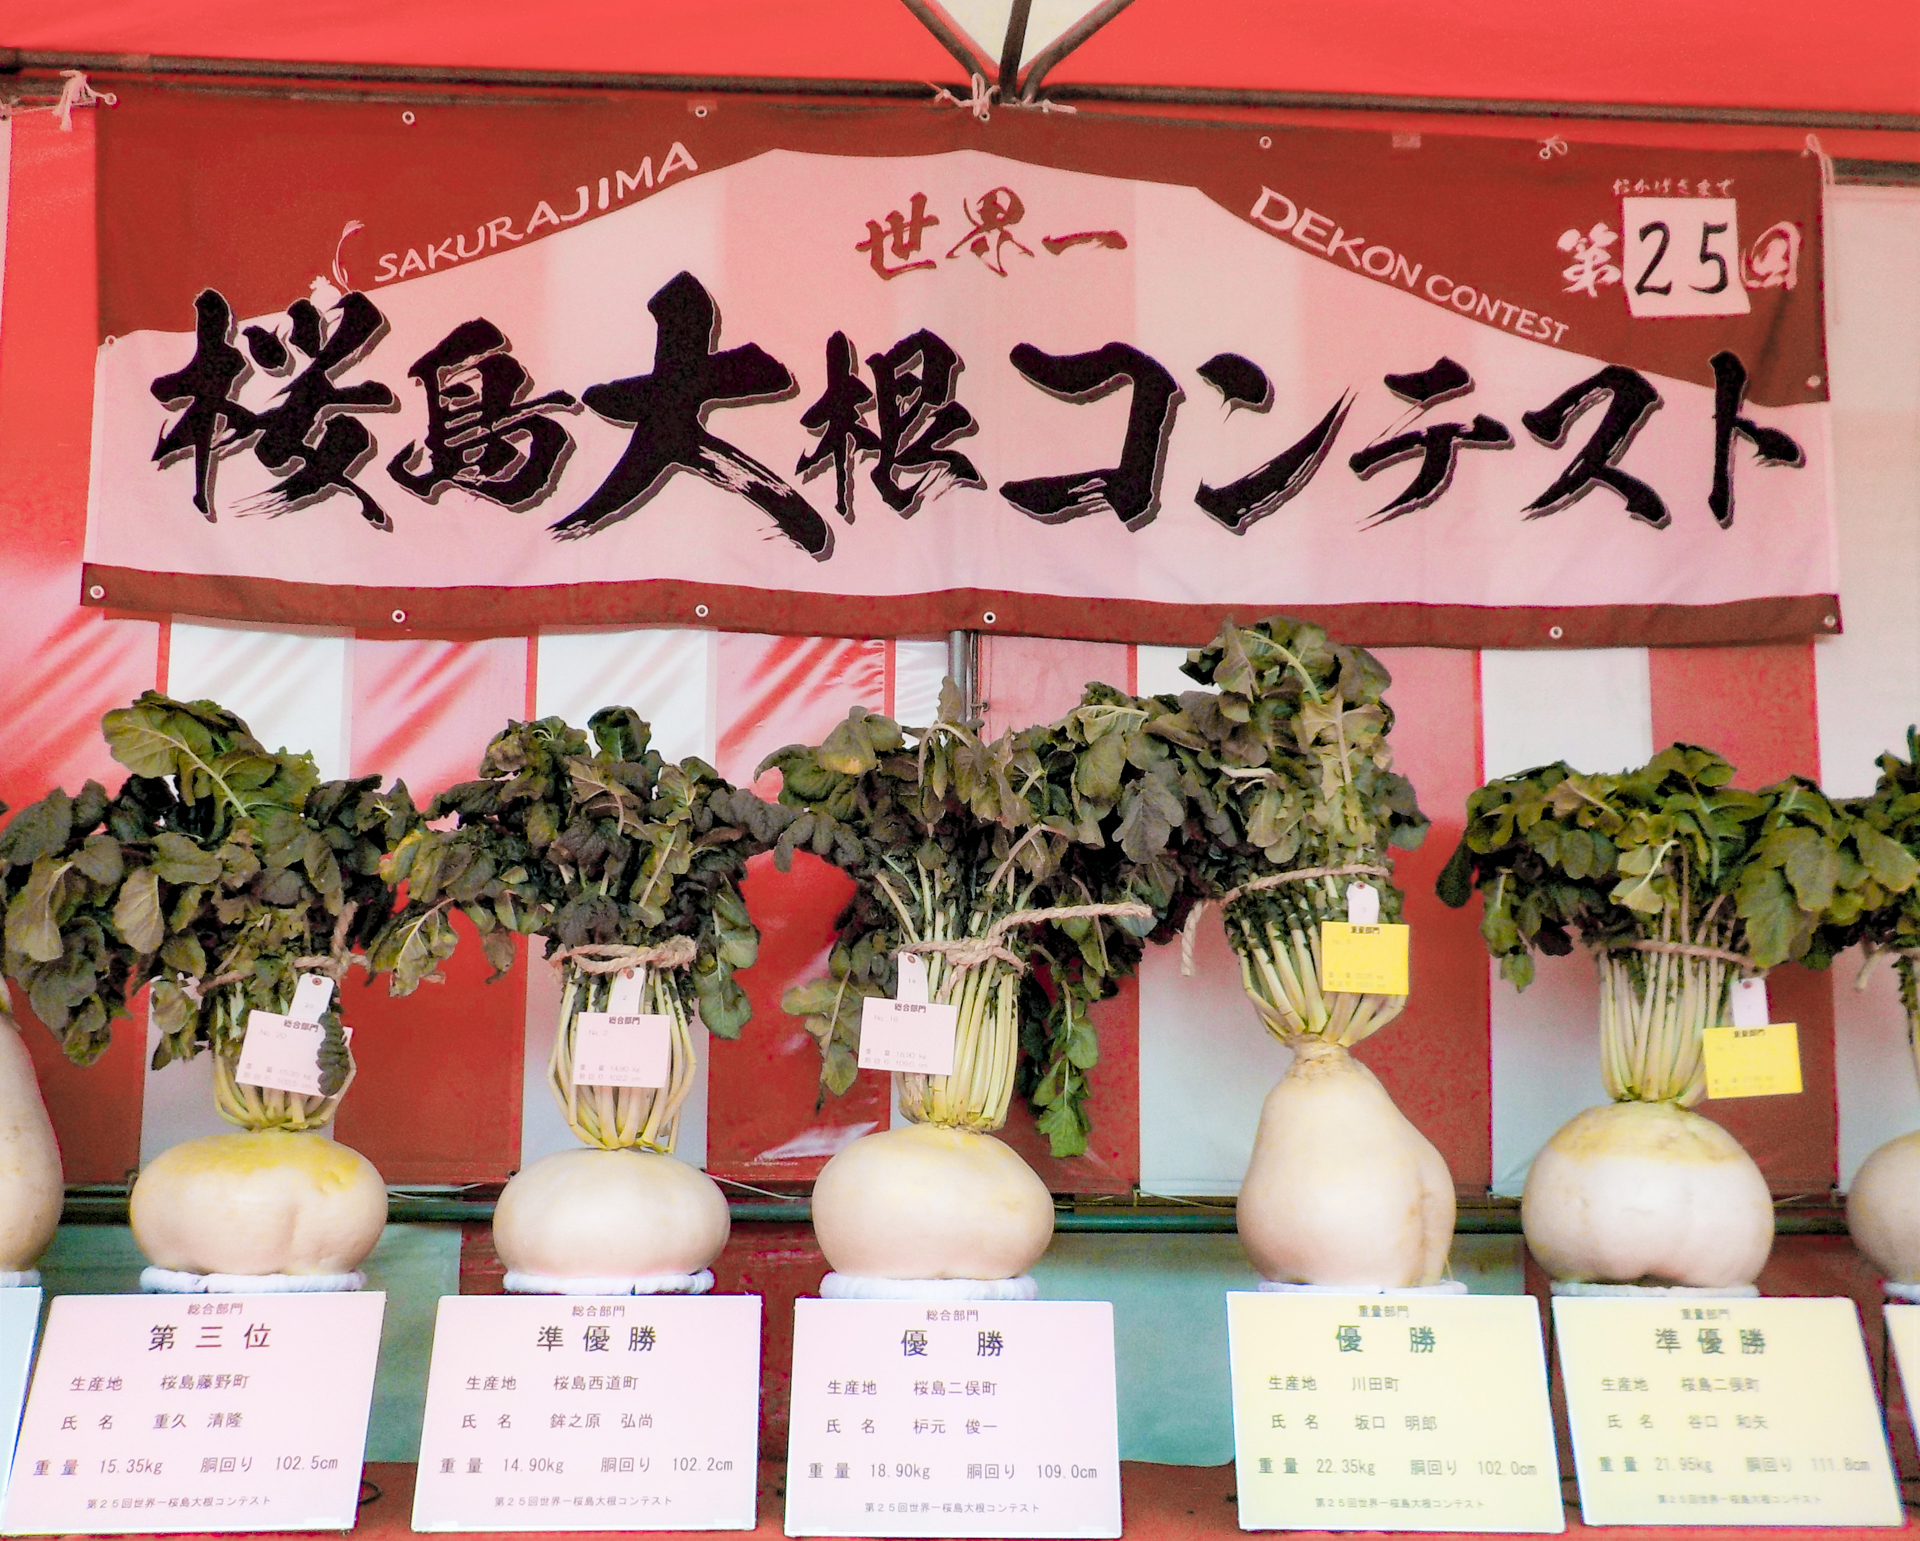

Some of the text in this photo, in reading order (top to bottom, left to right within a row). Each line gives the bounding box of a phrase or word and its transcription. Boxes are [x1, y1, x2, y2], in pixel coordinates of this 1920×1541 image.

[373, 141, 700, 283] SAKURAJIMA
[855, 186, 1128, 281] 世界一
[1249, 186, 1570, 346] DEKON CONTEST
[150, 271, 1807, 563] 桜島大根コンテスト
[894, 1003, 927, 1013] 総合部門
[284, 1019, 319, 1033] 総合部門
[609, 1016, 640, 1025] 総合部門
[187, 1302, 244, 1316] 総合部門
[572, 1305, 626, 1318] 総合部門
[926, 1309, 979, 1322] 総合部門
[1358, 1305, 1410, 1318] 重量部門
[148, 1323, 272, 1351] 第三位
[536, 1325, 657, 1353] 準優勝
[900, 1330, 1005, 1357] 優勝
[1336, 1325, 1437, 1354] 優勝
[1655, 1328, 1767, 1354] 準優勝
[69, 1373, 250, 1392] 生産地 桜島藤野町
[465, 1375, 639, 1391] 生産地 桜島西道町
[827, 1380, 998, 1396] 生産地 桜島二俣町
[1268, 1376, 1399, 1392] 生産地 川田町
[1601, 1377, 1649, 1392] 生産地
[152, 1412, 187, 1429] 重久
[207, 1411, 243, 1428] 清隆
[620, 1413, 654, 1429] 弘尚
[913, 1419, 946, 1434] 枦元
[965, 1419, 998, 1434] 俊一
[1354, 1415, 1386, 1431] 坂口
[1405, 1415, 1438, 1432] 明郎
[1688, 1414, 1719, 1430] 谷口
[1737, 1414, 1768, 1430] 和矢
[98, 1458, 164, 1476] 15.35kg
[199, 1456, 252, 1474] 胴回り
[274, 1455, 339, 1471] 102.5cm
[502, 1457, 564, 1474] 14.90kg
[600, 1457, 651, 1473] 胴回り
[671, 1457, 733, 1472] 102.2cm
[869, 1463, 931, 1480] 18.90kg
[966, 1464, 1016, 1480] 胴回り
[1037, 1464, 1098, 1480] 109.0cm
[1316, 1459, 1376, 1475] 22.35kg
[1410, 1459, 1458, 1475] 胴回り
[1477, 1461, 1538, 1476] 102.0cm
[1655, 1457, 1713, 1474] 21.95kg
